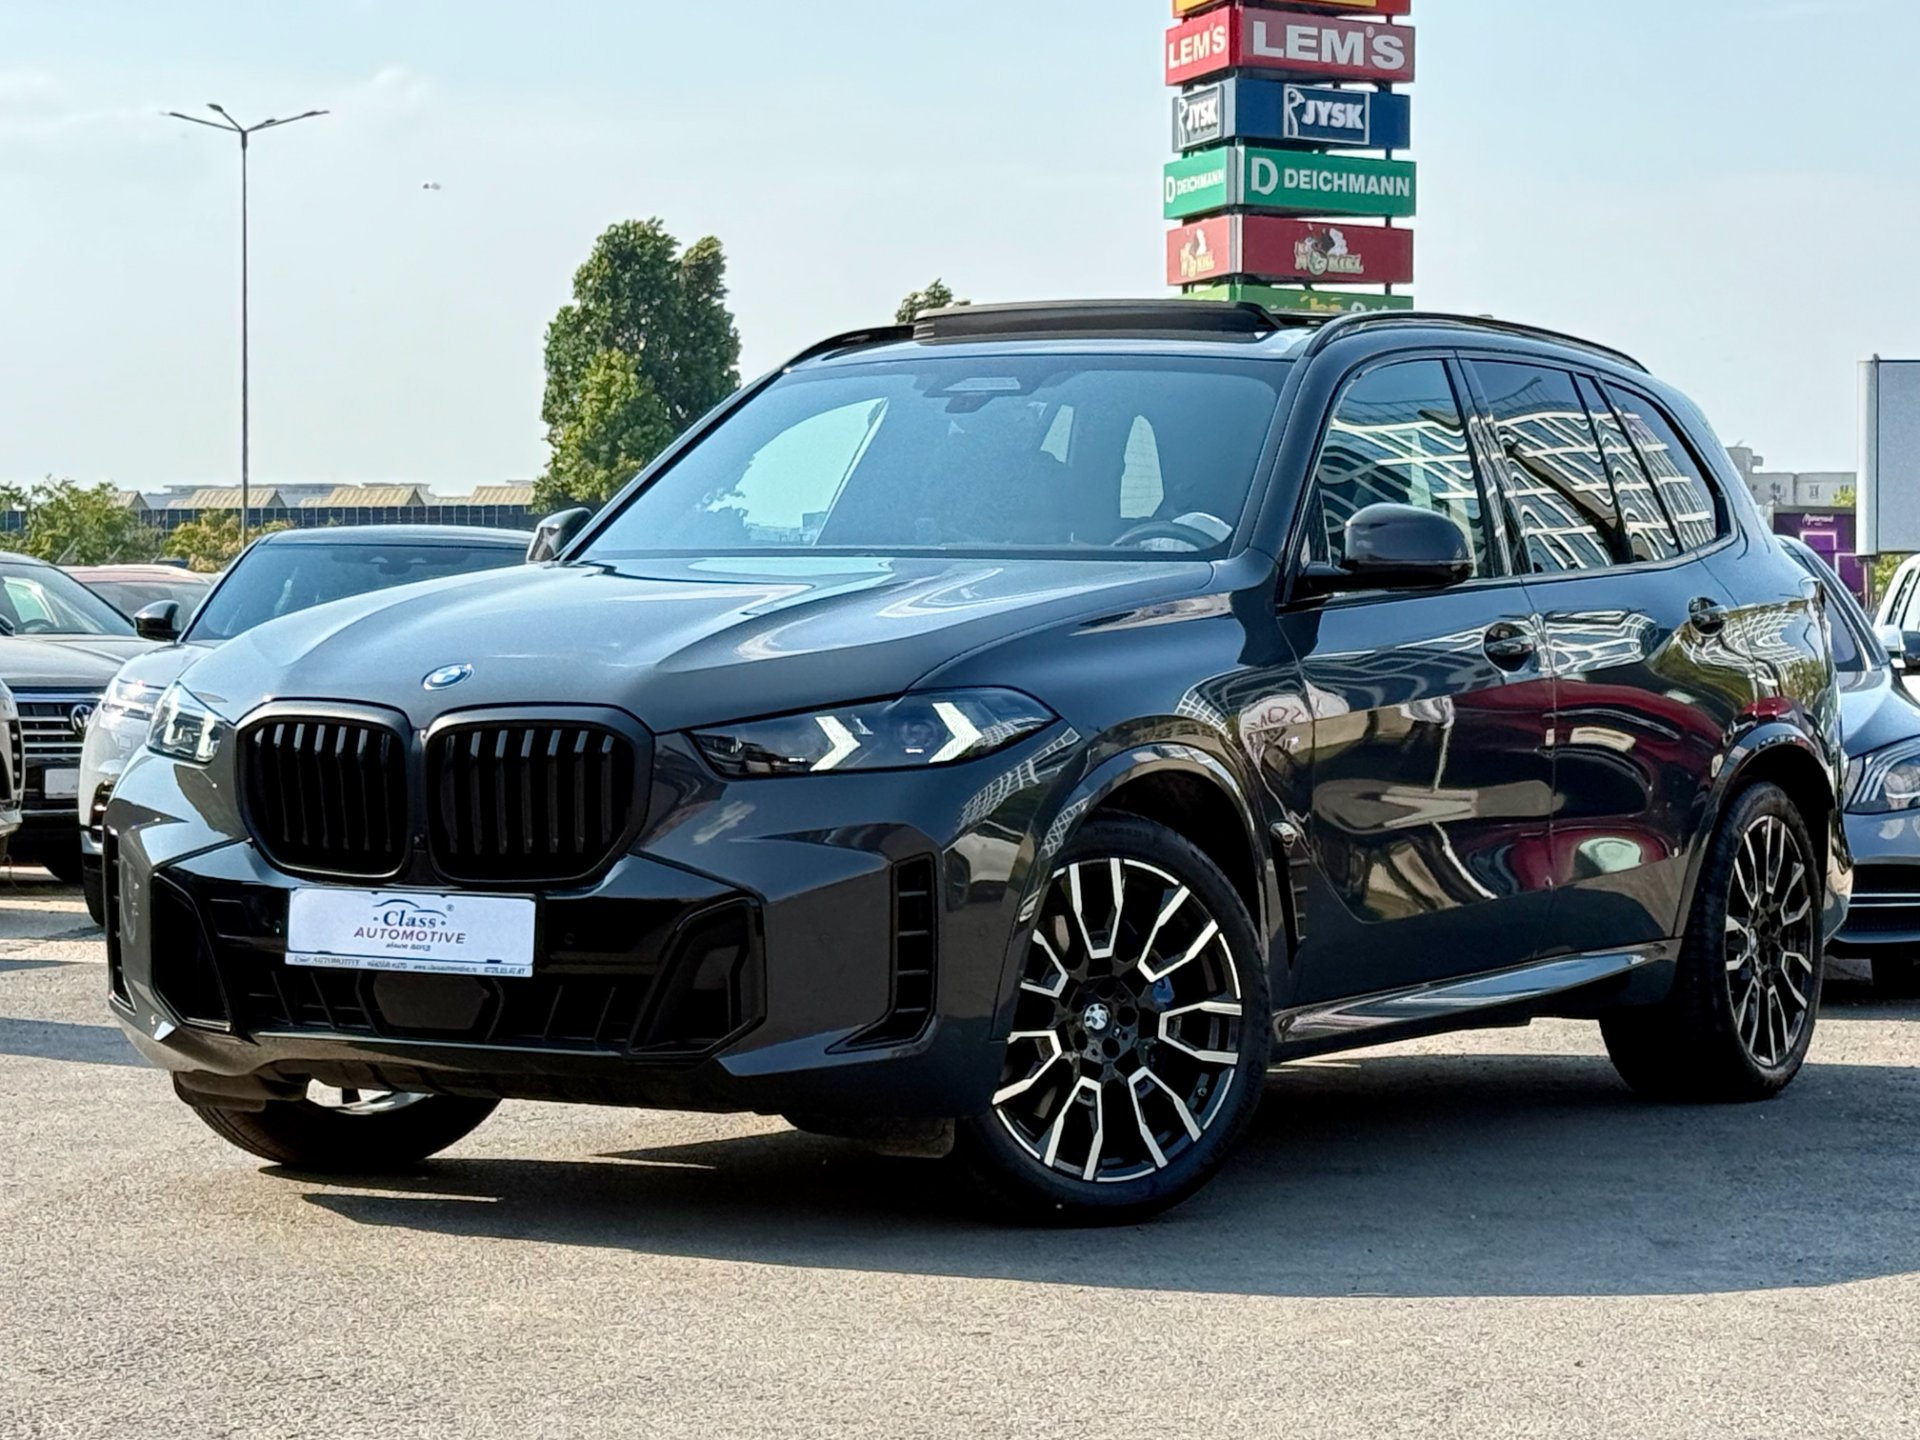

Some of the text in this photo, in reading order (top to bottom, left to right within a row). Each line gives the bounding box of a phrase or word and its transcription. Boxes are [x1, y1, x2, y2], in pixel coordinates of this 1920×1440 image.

[1168, 24, 1227, 69] LEM'S
[1252, 21, 1405, 70] LEM'S
[1186, 98, 1218, 131] JYSK
[1301, 101, 1364, 130] JYSK
[1176, 168, 1224, 196] DEICHMANN
[1283, 168, 1410, 197] DEICHMANN
[383, 909, 437, 929] Class
[354, 927, 467, 945] AUTOMOTIVE
